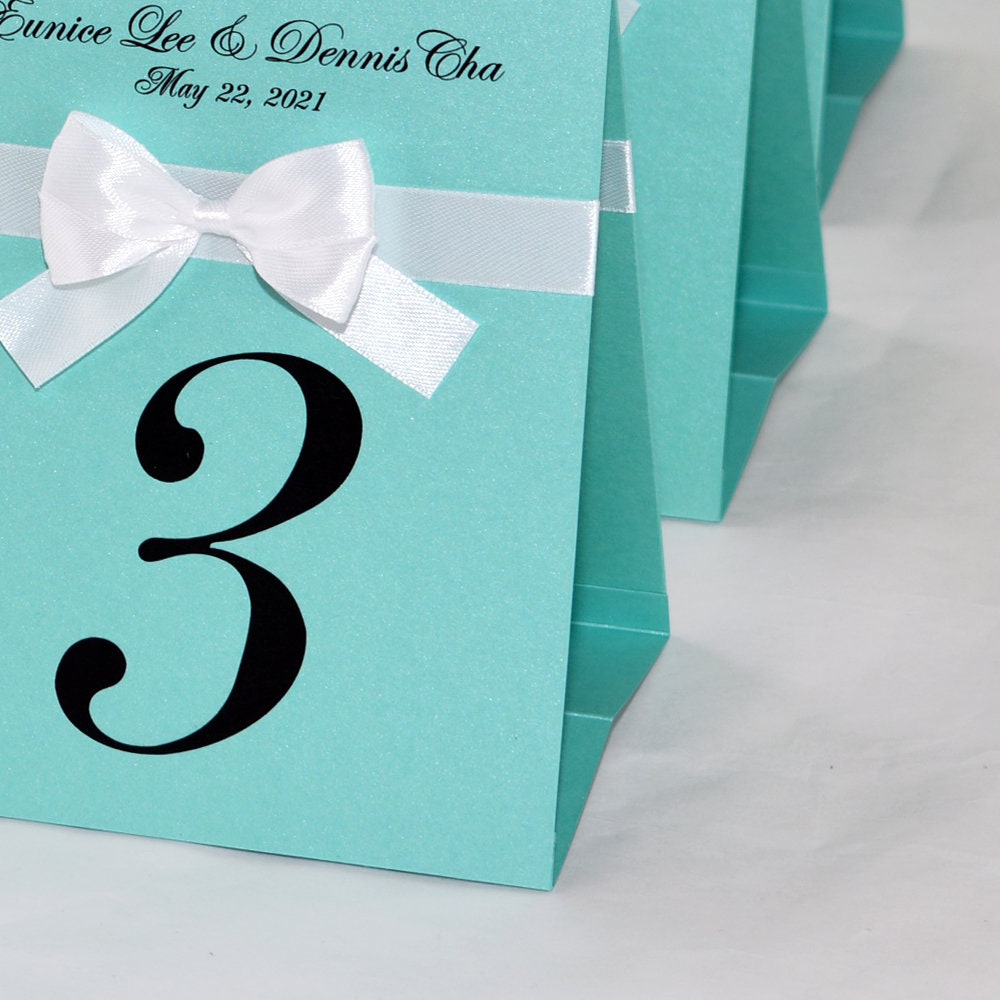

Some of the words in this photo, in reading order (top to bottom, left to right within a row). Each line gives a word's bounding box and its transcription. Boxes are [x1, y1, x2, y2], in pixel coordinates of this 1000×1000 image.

[120, 5, 196, 53] Lee
[210, 14, 257, 60] &
[265, 20, 410, 73] Dennis
[416, 29, 505, 82] Cha
[134, 66, 210, 109] May
[215, 83, 252, 109] 22,
[263, 87, 326, 111] 2021
[54, 351, 363, 756] 3
